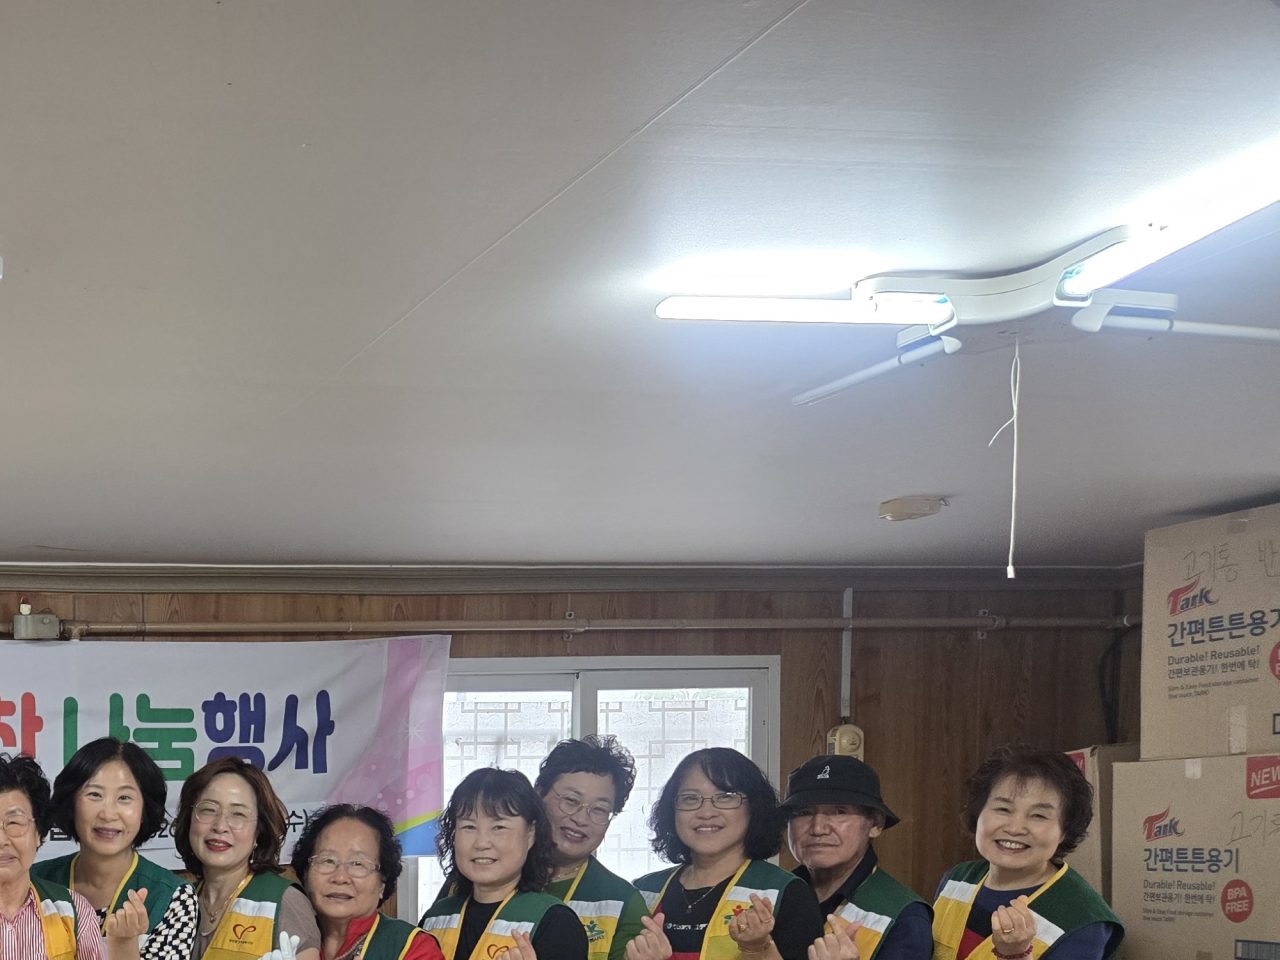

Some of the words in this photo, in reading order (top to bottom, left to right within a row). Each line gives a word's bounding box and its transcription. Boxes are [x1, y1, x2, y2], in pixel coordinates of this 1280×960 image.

[1167, 577, 1219, 617] Tark
[1168, 651, 1208, 666] Durable!
[1211, 645, 1260, 661] Reusable!
[1143, 807, 1185, 842] Tark
[1143, 848, 1239, 873] 간편튼튼용기
[1143, 880, 1174, 890] Durable!
[1177, 880, 1216, 891] Reusable!
[1227, 887, 1247, 900] BPA
[1225, 900, 1250, 914] FREE
